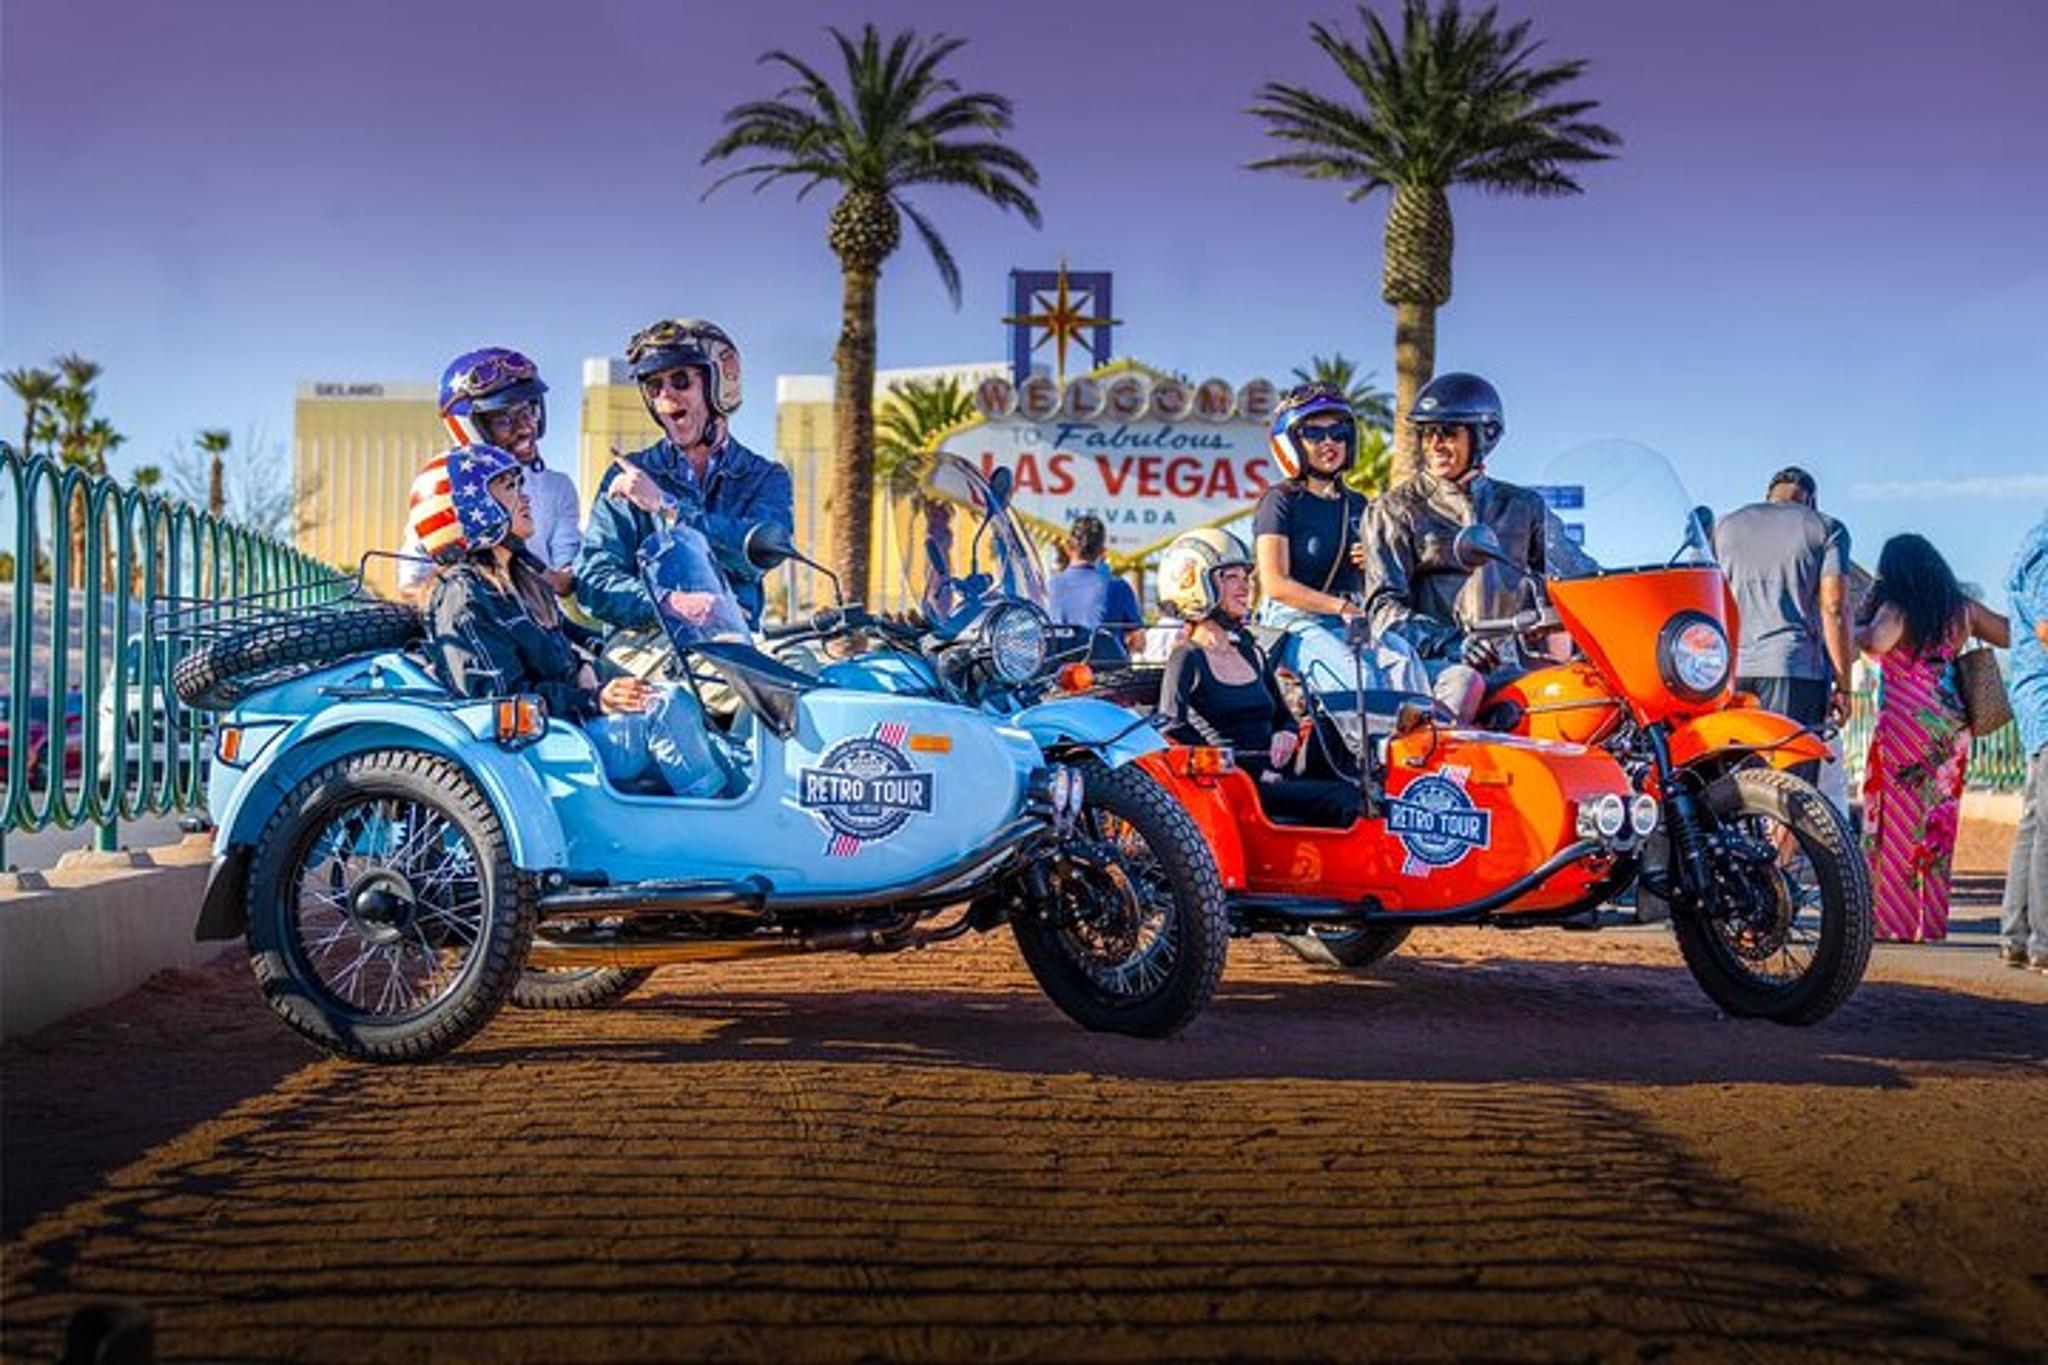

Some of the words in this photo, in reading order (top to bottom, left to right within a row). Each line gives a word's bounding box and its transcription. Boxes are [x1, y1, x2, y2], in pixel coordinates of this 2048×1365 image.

[981, 383, 1270, 414] WELCOME
[1012, 425, 1042, 446] TO
[1053, 423, 1233, 449] Fabulous
[1095, 455, 1270, 499] VEGAS
[807, 775, 863, 802] RETRO
[872, 781, 922, 805] TOUR
[1390, 804, 1434, 831] RETRO
[1440, 815, 1480, 839] TOUR
